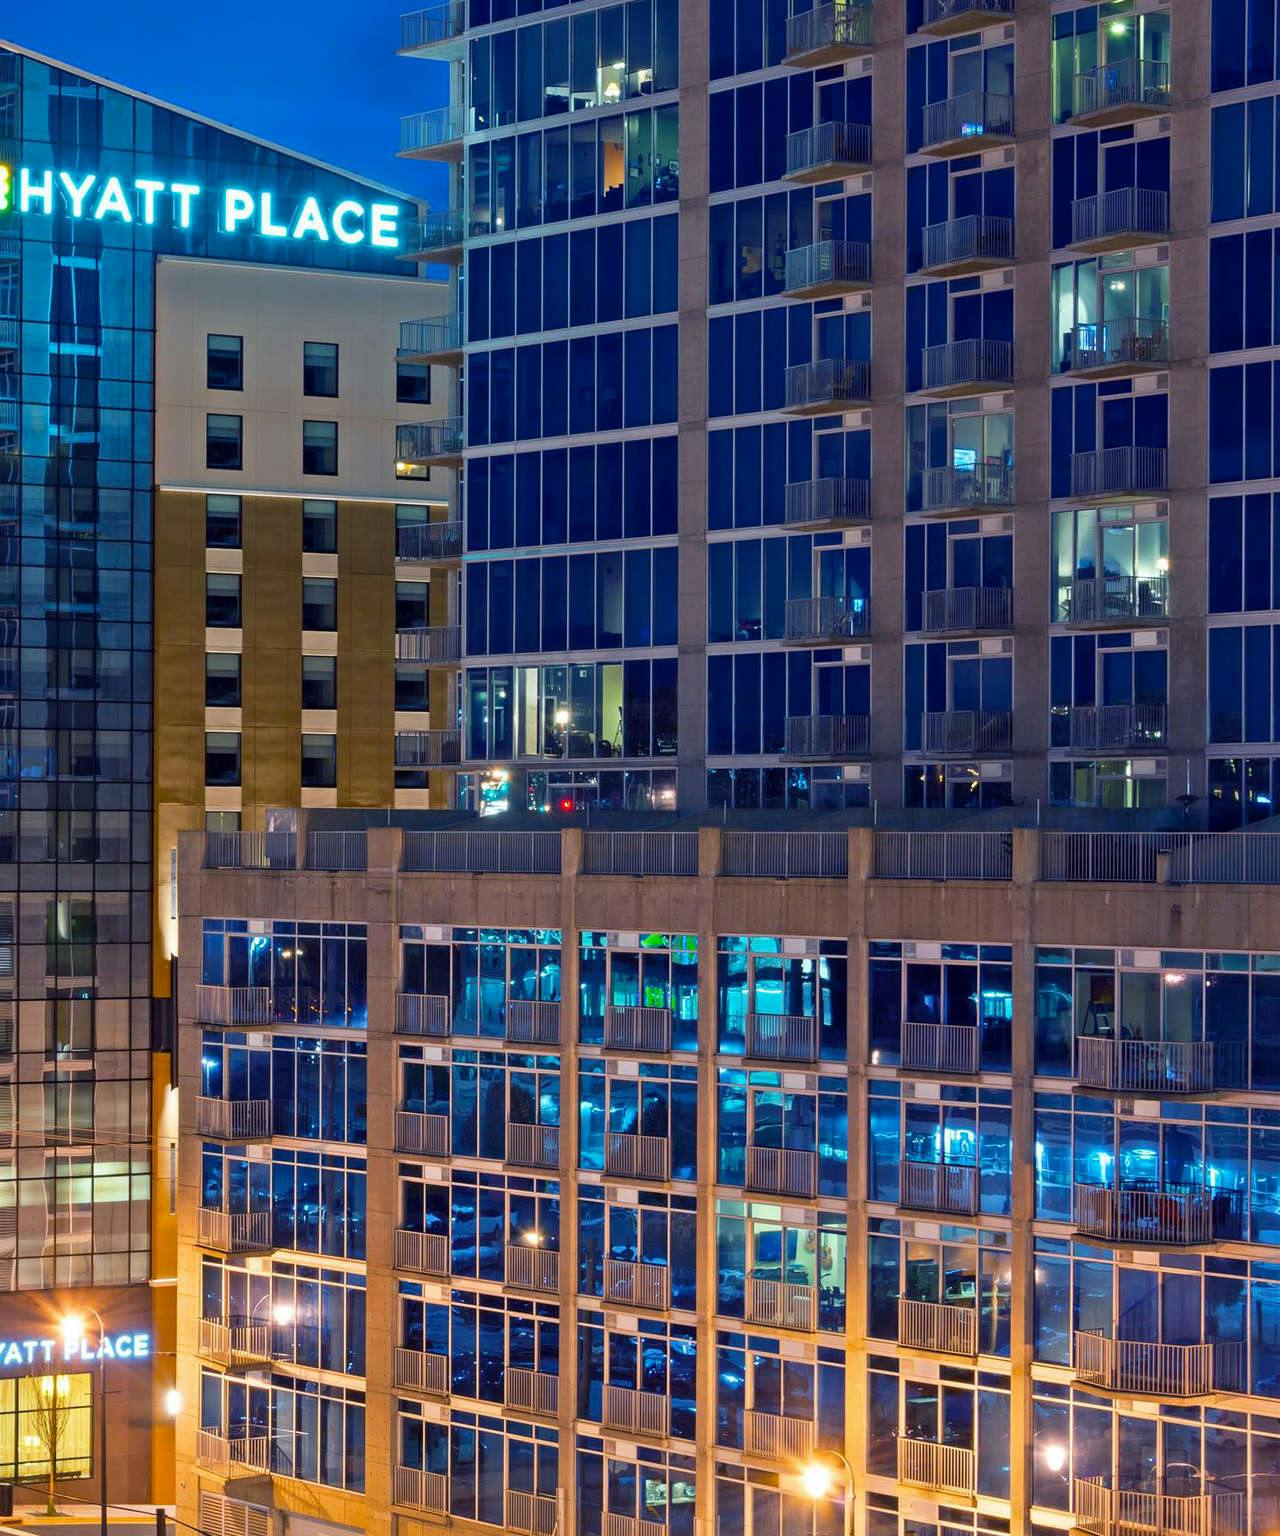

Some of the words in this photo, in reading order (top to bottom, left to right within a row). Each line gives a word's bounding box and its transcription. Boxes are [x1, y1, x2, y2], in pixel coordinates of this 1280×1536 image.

[19, 167, 201, 229] HYATT
[224, 187, 400, 248] PLACE
[63, 1333, 149, 1361] PLACE
